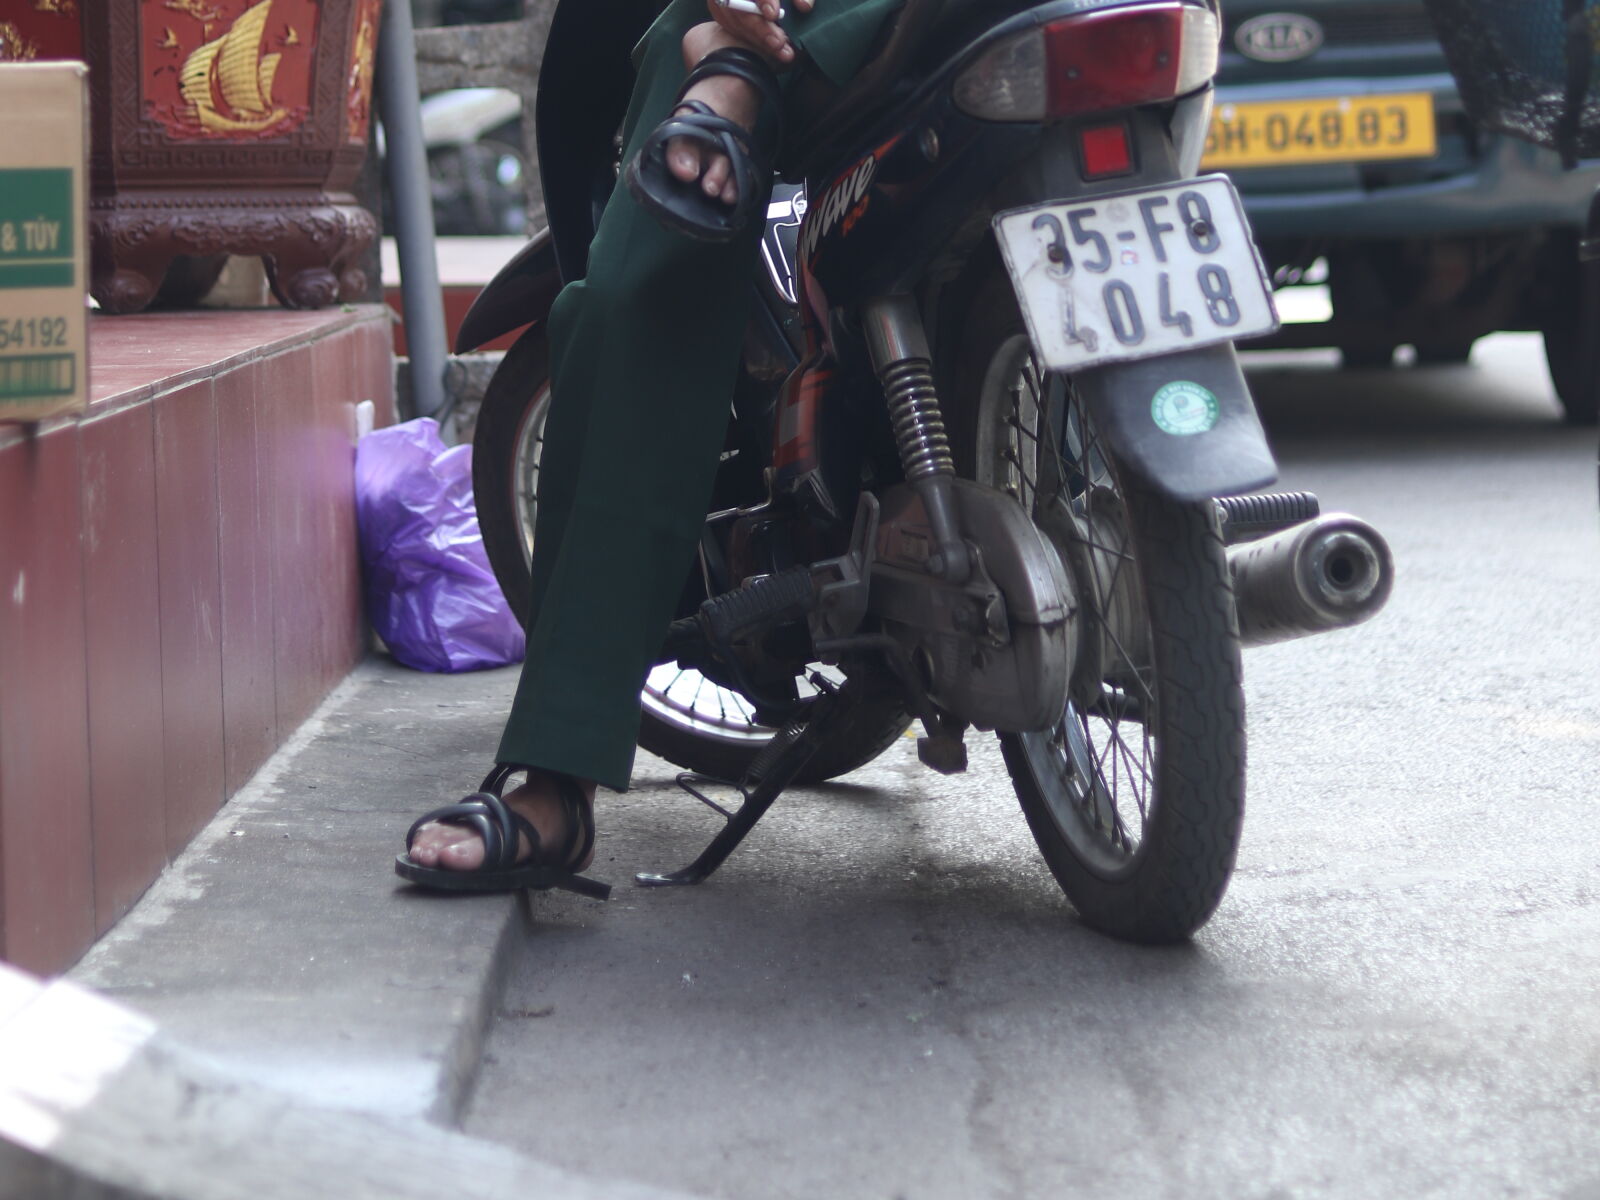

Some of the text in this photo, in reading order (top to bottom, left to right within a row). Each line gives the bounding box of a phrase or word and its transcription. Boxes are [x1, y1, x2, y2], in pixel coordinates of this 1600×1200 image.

[1249, 25, 1314, 50] KIA
[1, 221, 18, 253] &
[1062, 263, 1241, 353] 4048
